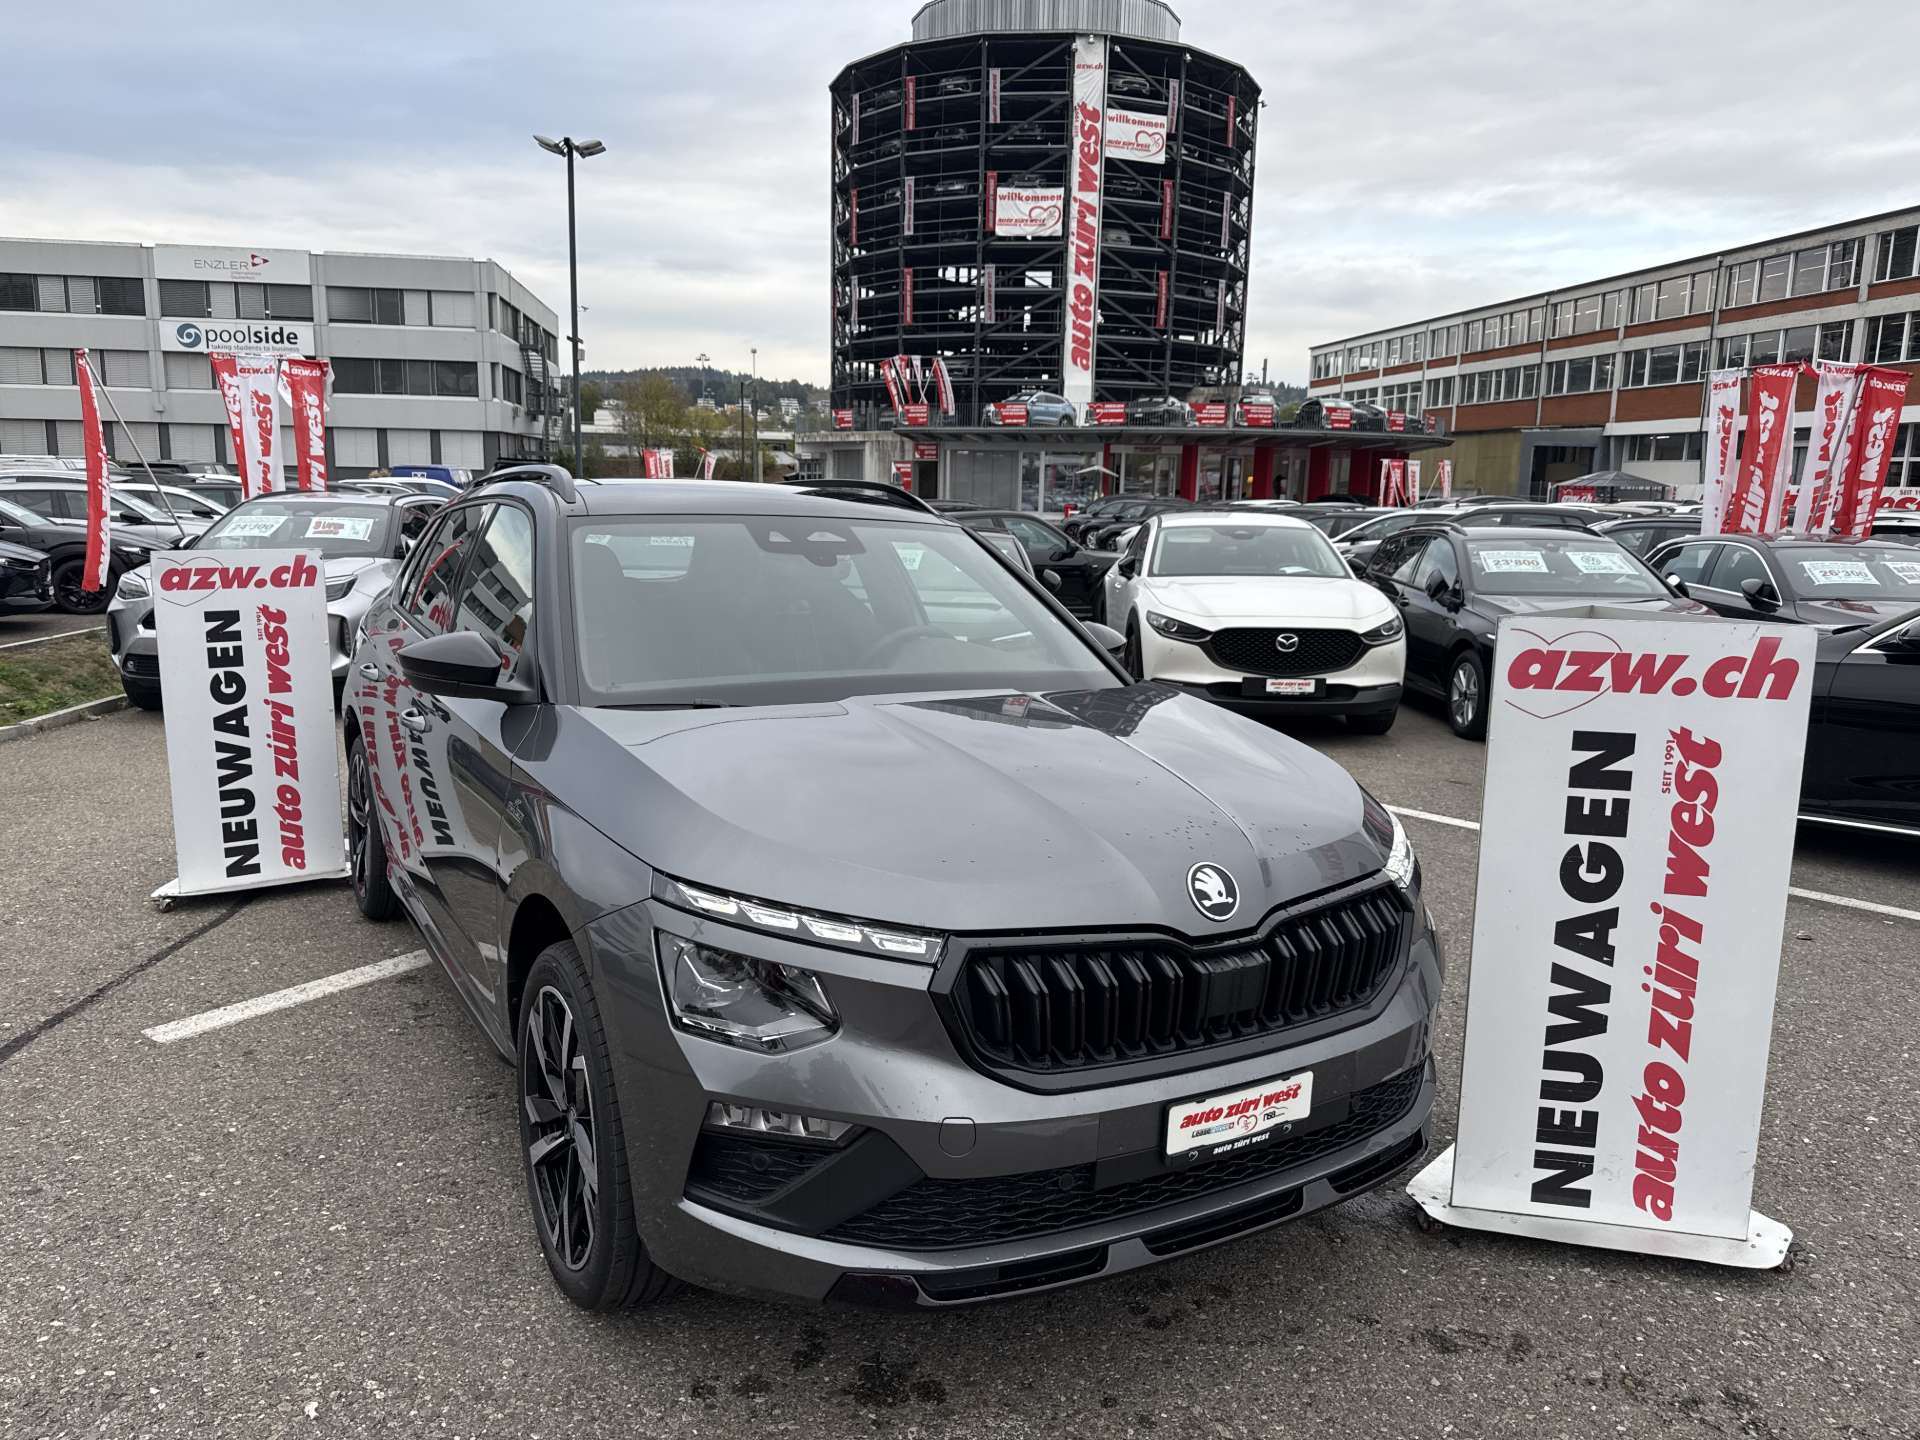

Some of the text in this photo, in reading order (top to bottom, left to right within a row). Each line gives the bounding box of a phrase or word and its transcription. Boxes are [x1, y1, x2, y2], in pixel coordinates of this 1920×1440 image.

[1107, 113, 1166, 129] willkommen
[998, 192, 1062, 202] willkommen
[1068, 101, 1101, 371] auto züri west
[194, 259, 249, 271] ENZLER
[205, 325, 299, 349] poolside
[211, 344, 232, 352] taking
[234, 344, 261, 352] students
[272, 345, 300, 353] business
[239, 366, 275, 375] azw.ch
[250, 389, 273, 457] west
[303, 390, 325, 456] west
[160, 555, 318, 591] azw.ch
[1507, 636, 1800, 700] azw.ch
[204, 610, 261, 878] NEUWAGEN
[257, 604, 306, 870] auto züri west
[1661, 740, 1676, 794] SEIT 1991
[1531, 730, 1636, 1208] NEUWAGEN
[1632, 726, 1722, 1222] auto züri west
[1180, 1083, 1303, 1130] auto züri west
[1213, 1132, 1271, 1155] auto züri west
